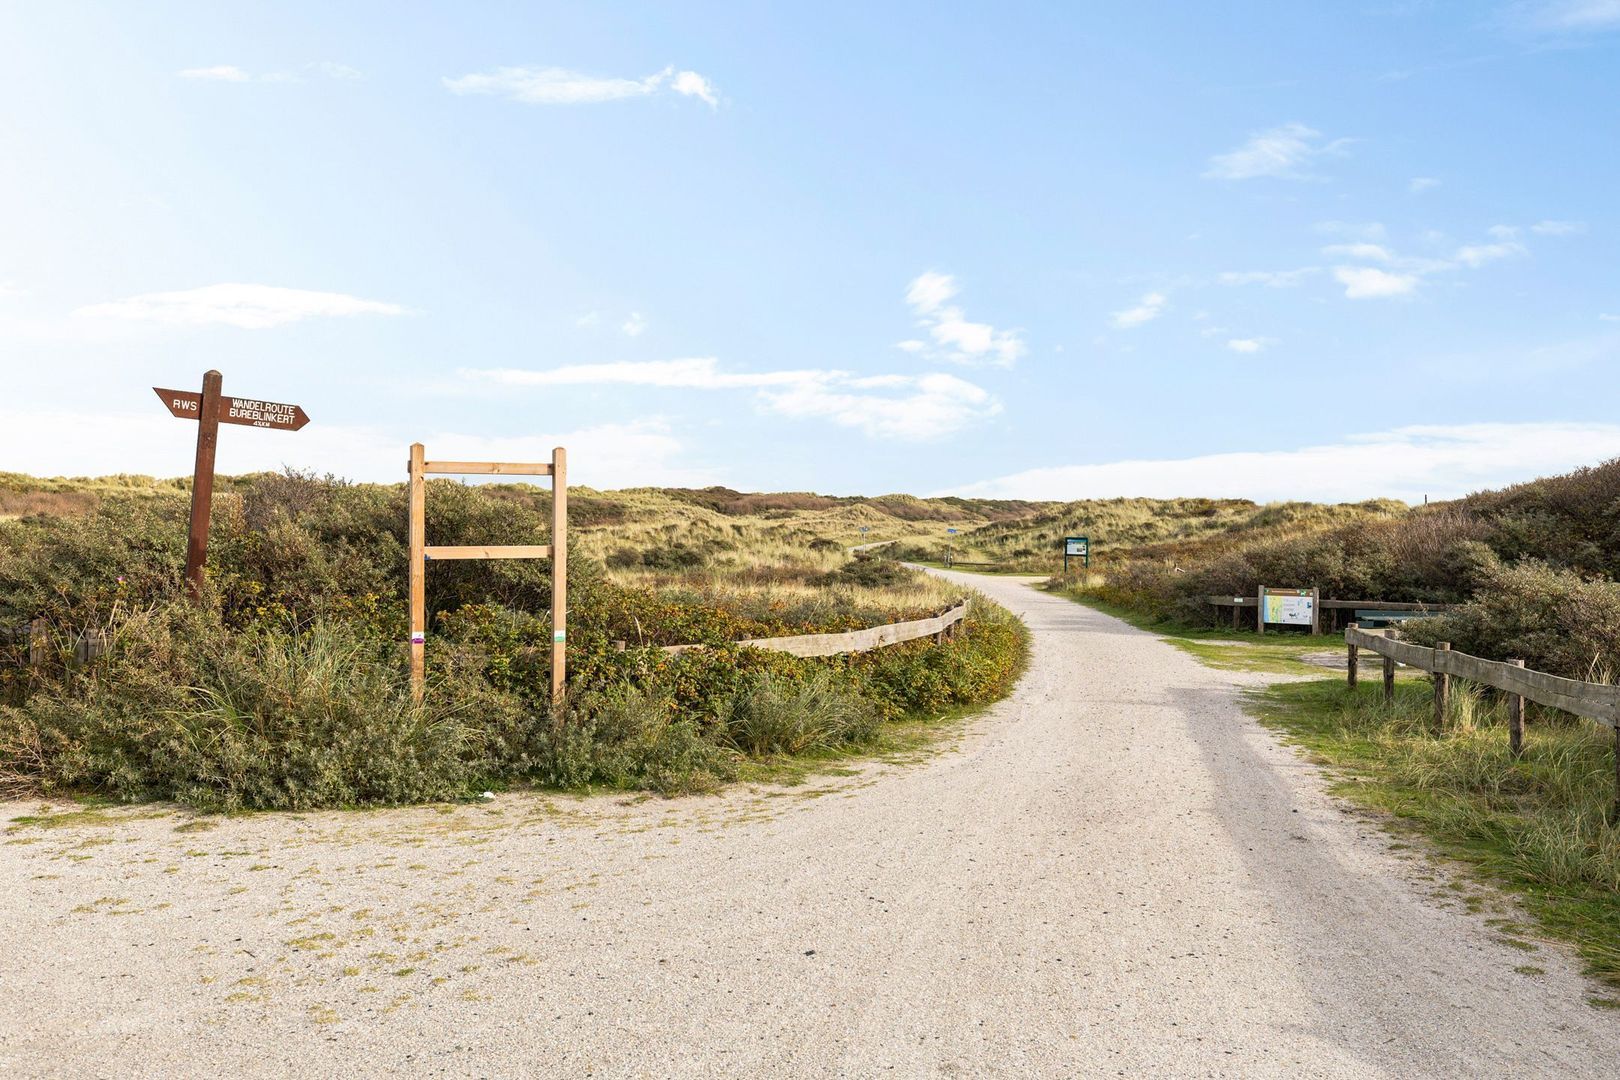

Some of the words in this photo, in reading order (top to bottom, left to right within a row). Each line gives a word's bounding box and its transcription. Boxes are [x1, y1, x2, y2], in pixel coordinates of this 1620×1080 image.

[173, 399, 197, 411] RWS
[232, 399, 295, 415] WANDELROUTE
[229, 408, 296, 424] BUREBLINKERT
